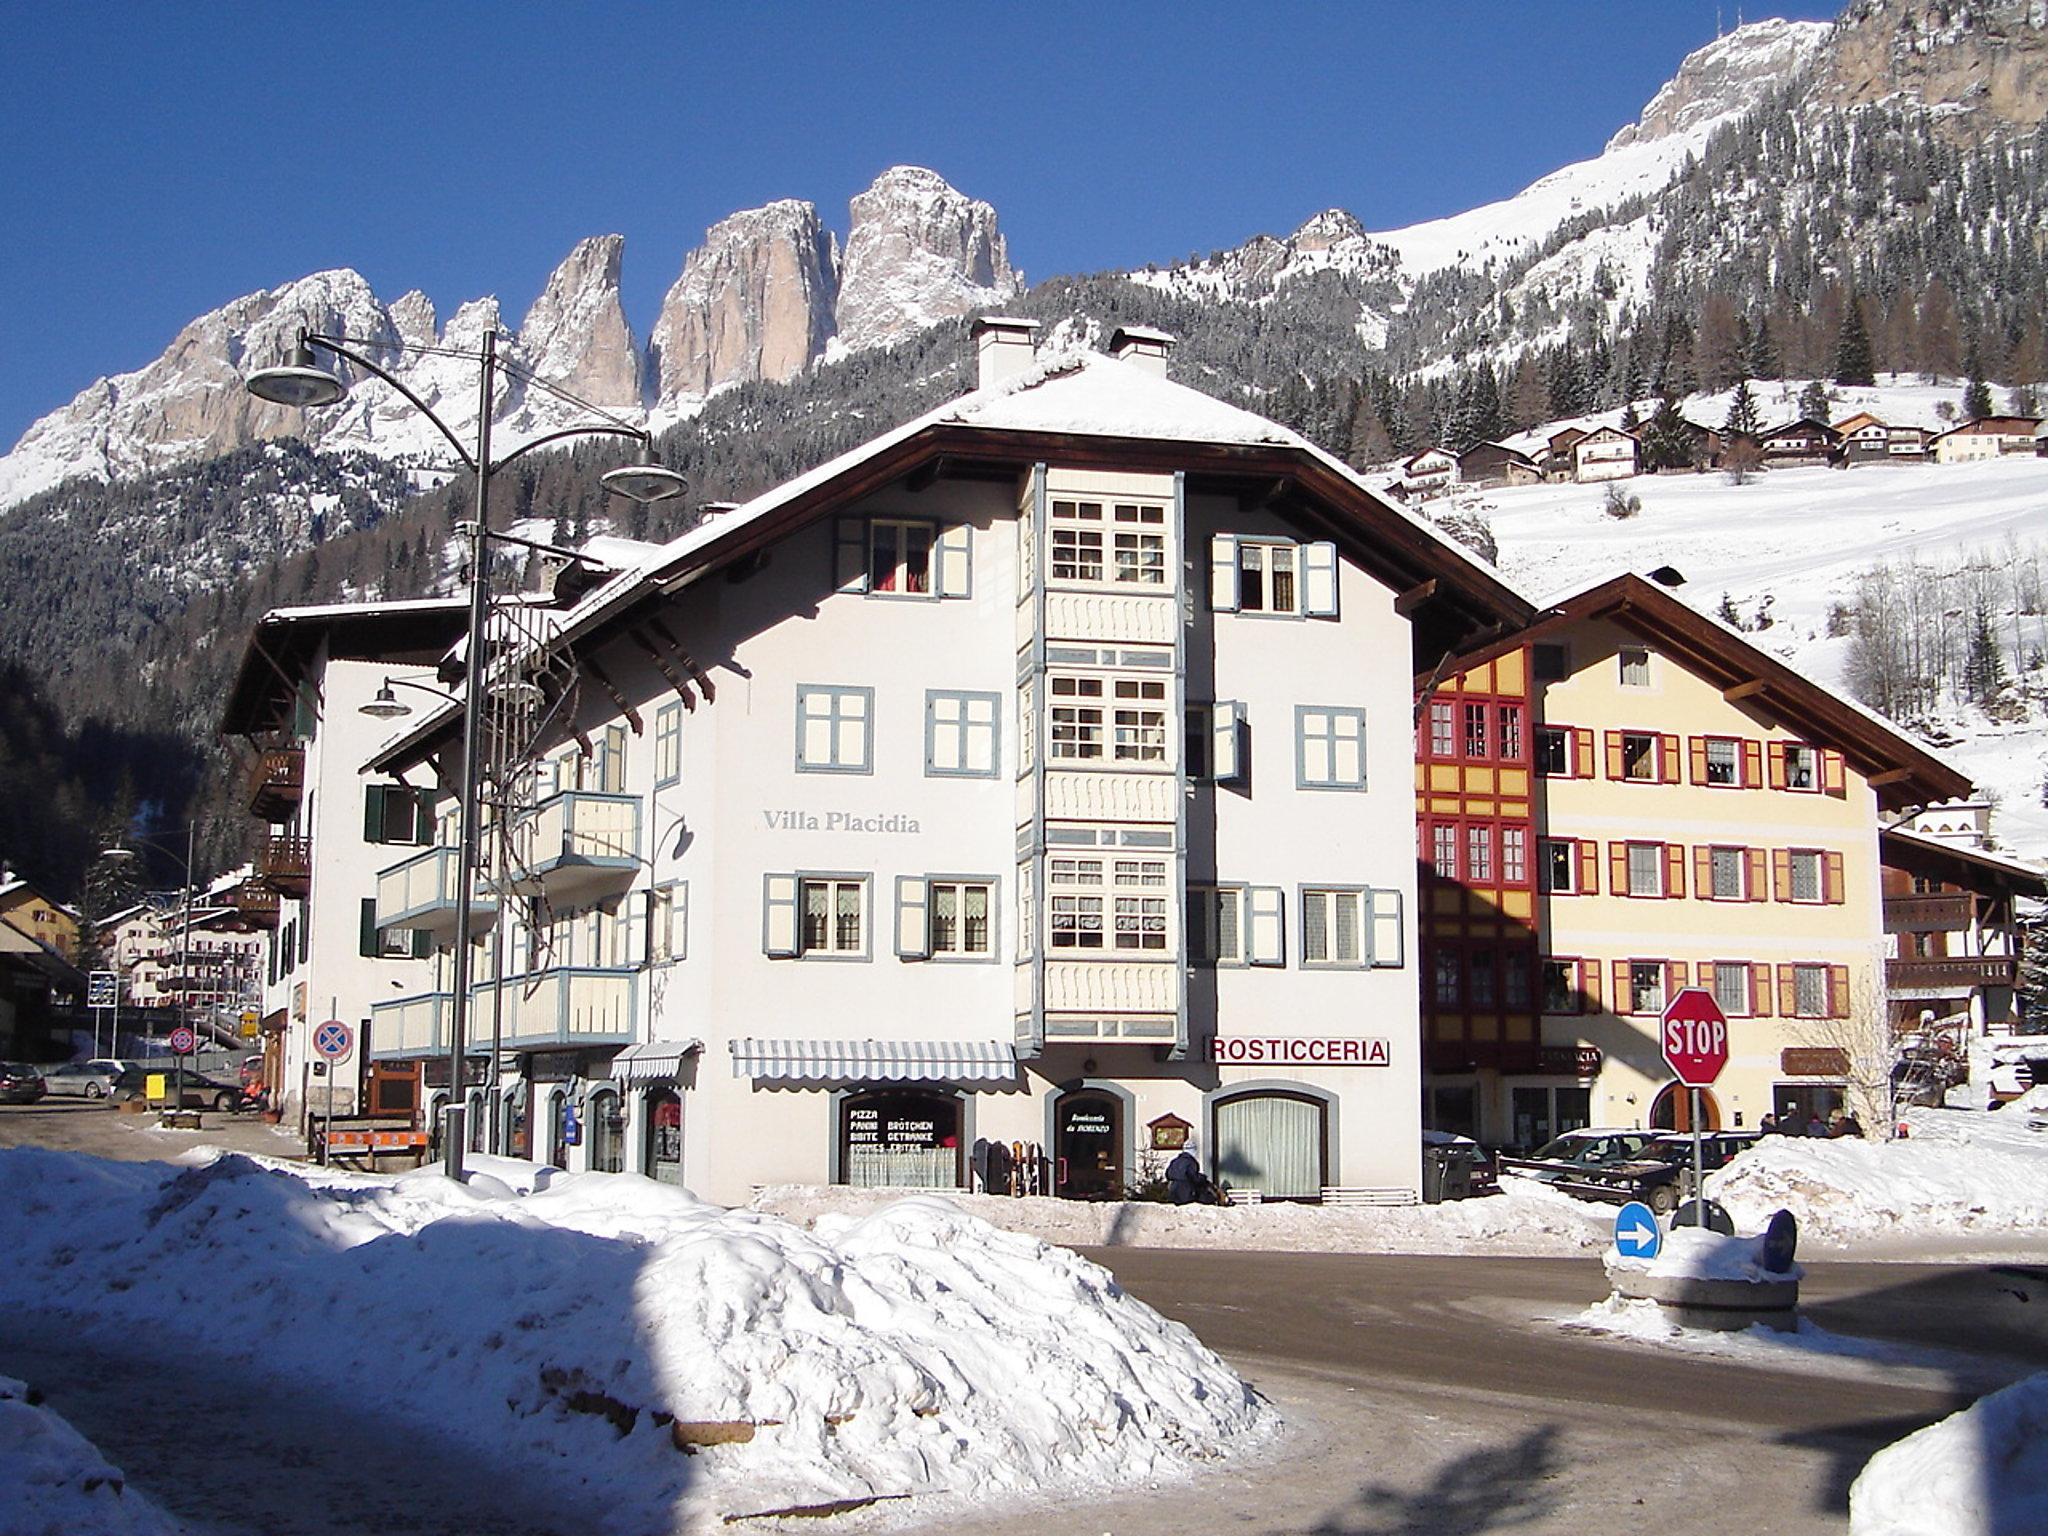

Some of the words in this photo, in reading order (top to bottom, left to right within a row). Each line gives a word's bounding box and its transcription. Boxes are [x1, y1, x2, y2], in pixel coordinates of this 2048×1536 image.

[763, 810, 819, 830] Villa
[825, 812, 920, 833] Placidia
[1667, 1019, 1724, 1055] STOP
[1211, 1039, 1385, 1060] ROSTICCERIA
[850, 1110, 877, 1119] PIZZA
